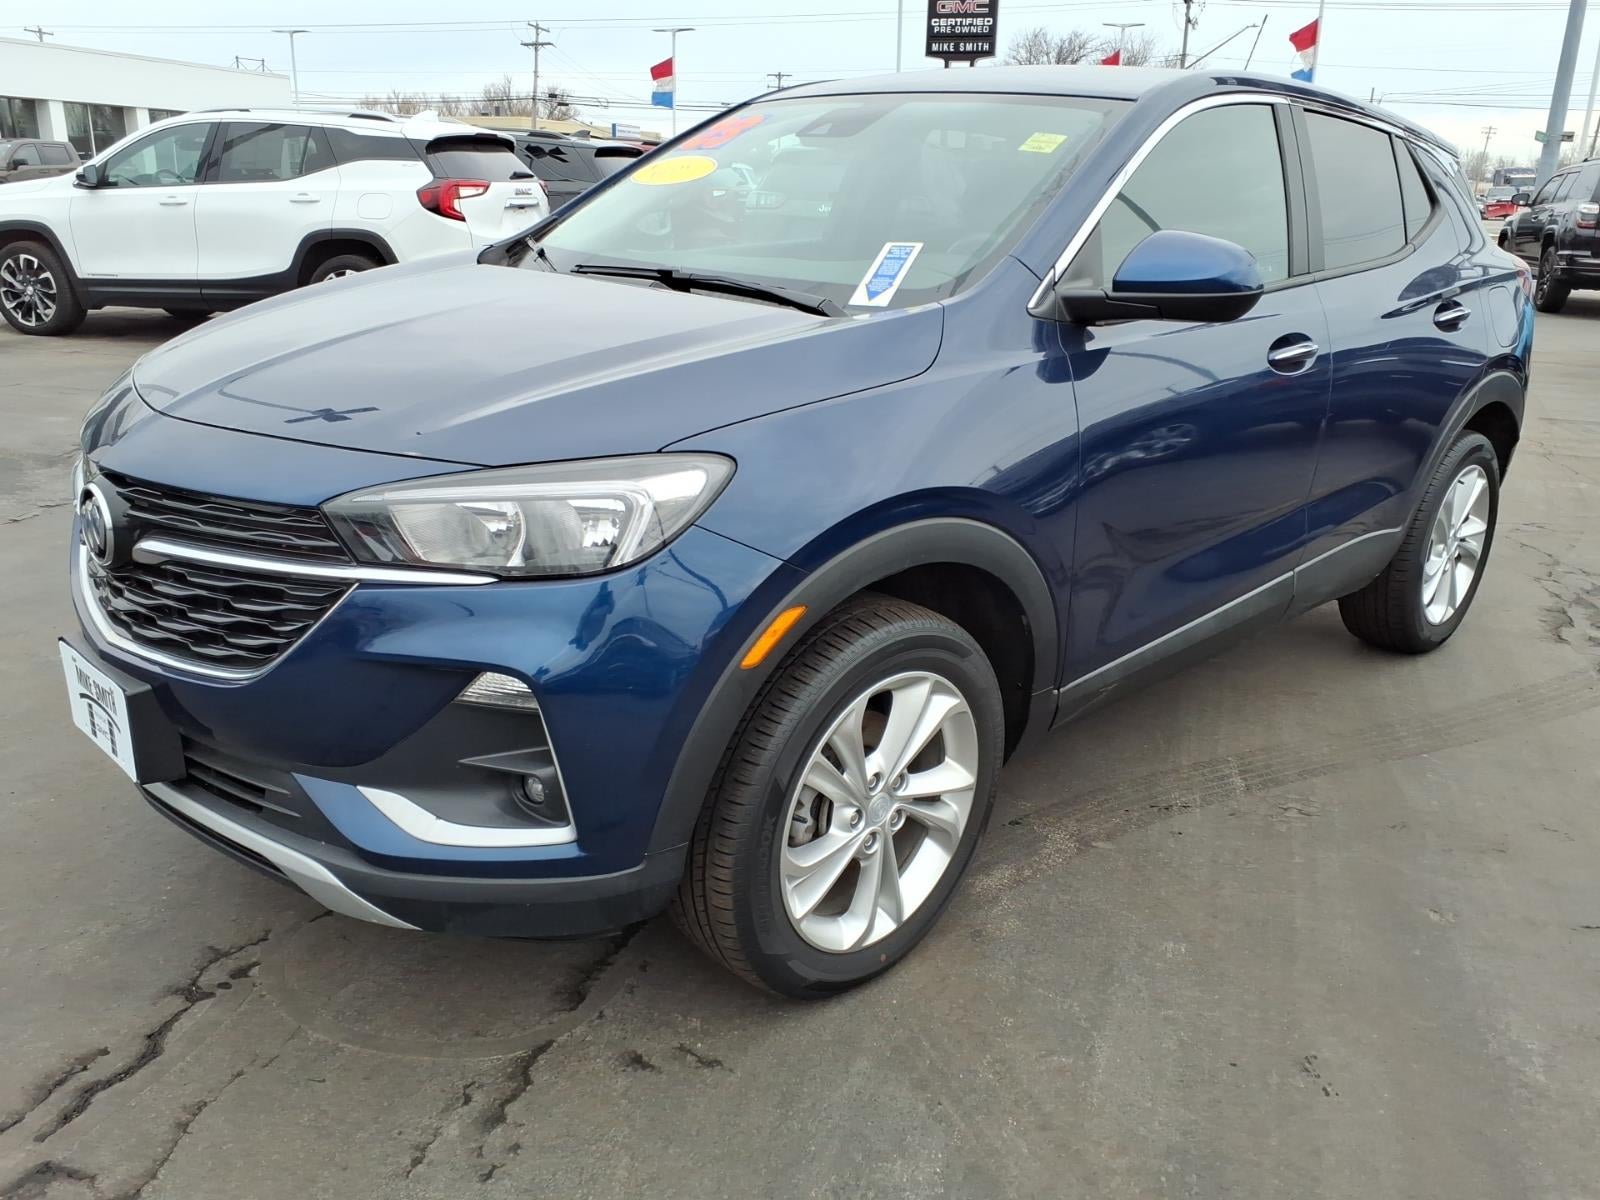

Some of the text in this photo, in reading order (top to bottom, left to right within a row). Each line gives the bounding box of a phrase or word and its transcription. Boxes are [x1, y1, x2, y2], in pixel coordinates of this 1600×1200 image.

[937, 0, 989, 13] GMC
[931, 18, 993, 26] CERTIFIED
[931, 42, 989, 51] MIKE SMITH
[75, 664, 117, 715] MIKE SMITH
